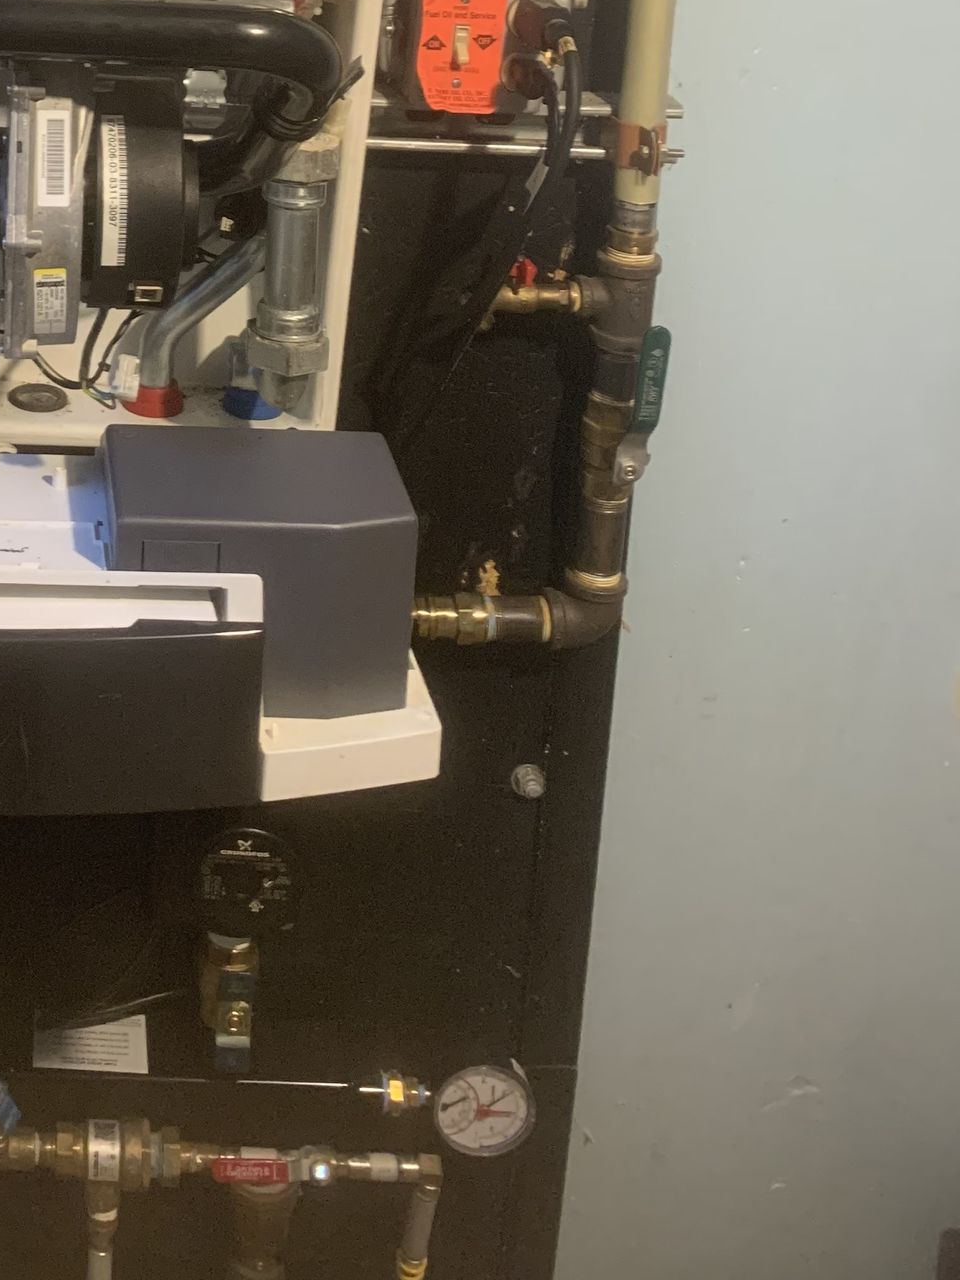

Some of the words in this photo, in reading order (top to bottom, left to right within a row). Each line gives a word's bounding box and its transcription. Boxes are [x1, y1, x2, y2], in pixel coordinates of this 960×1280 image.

[442, 10, 453, 18] Oil
[454, 11, 468, 19] and
[470, 11, 497, 20] Service
